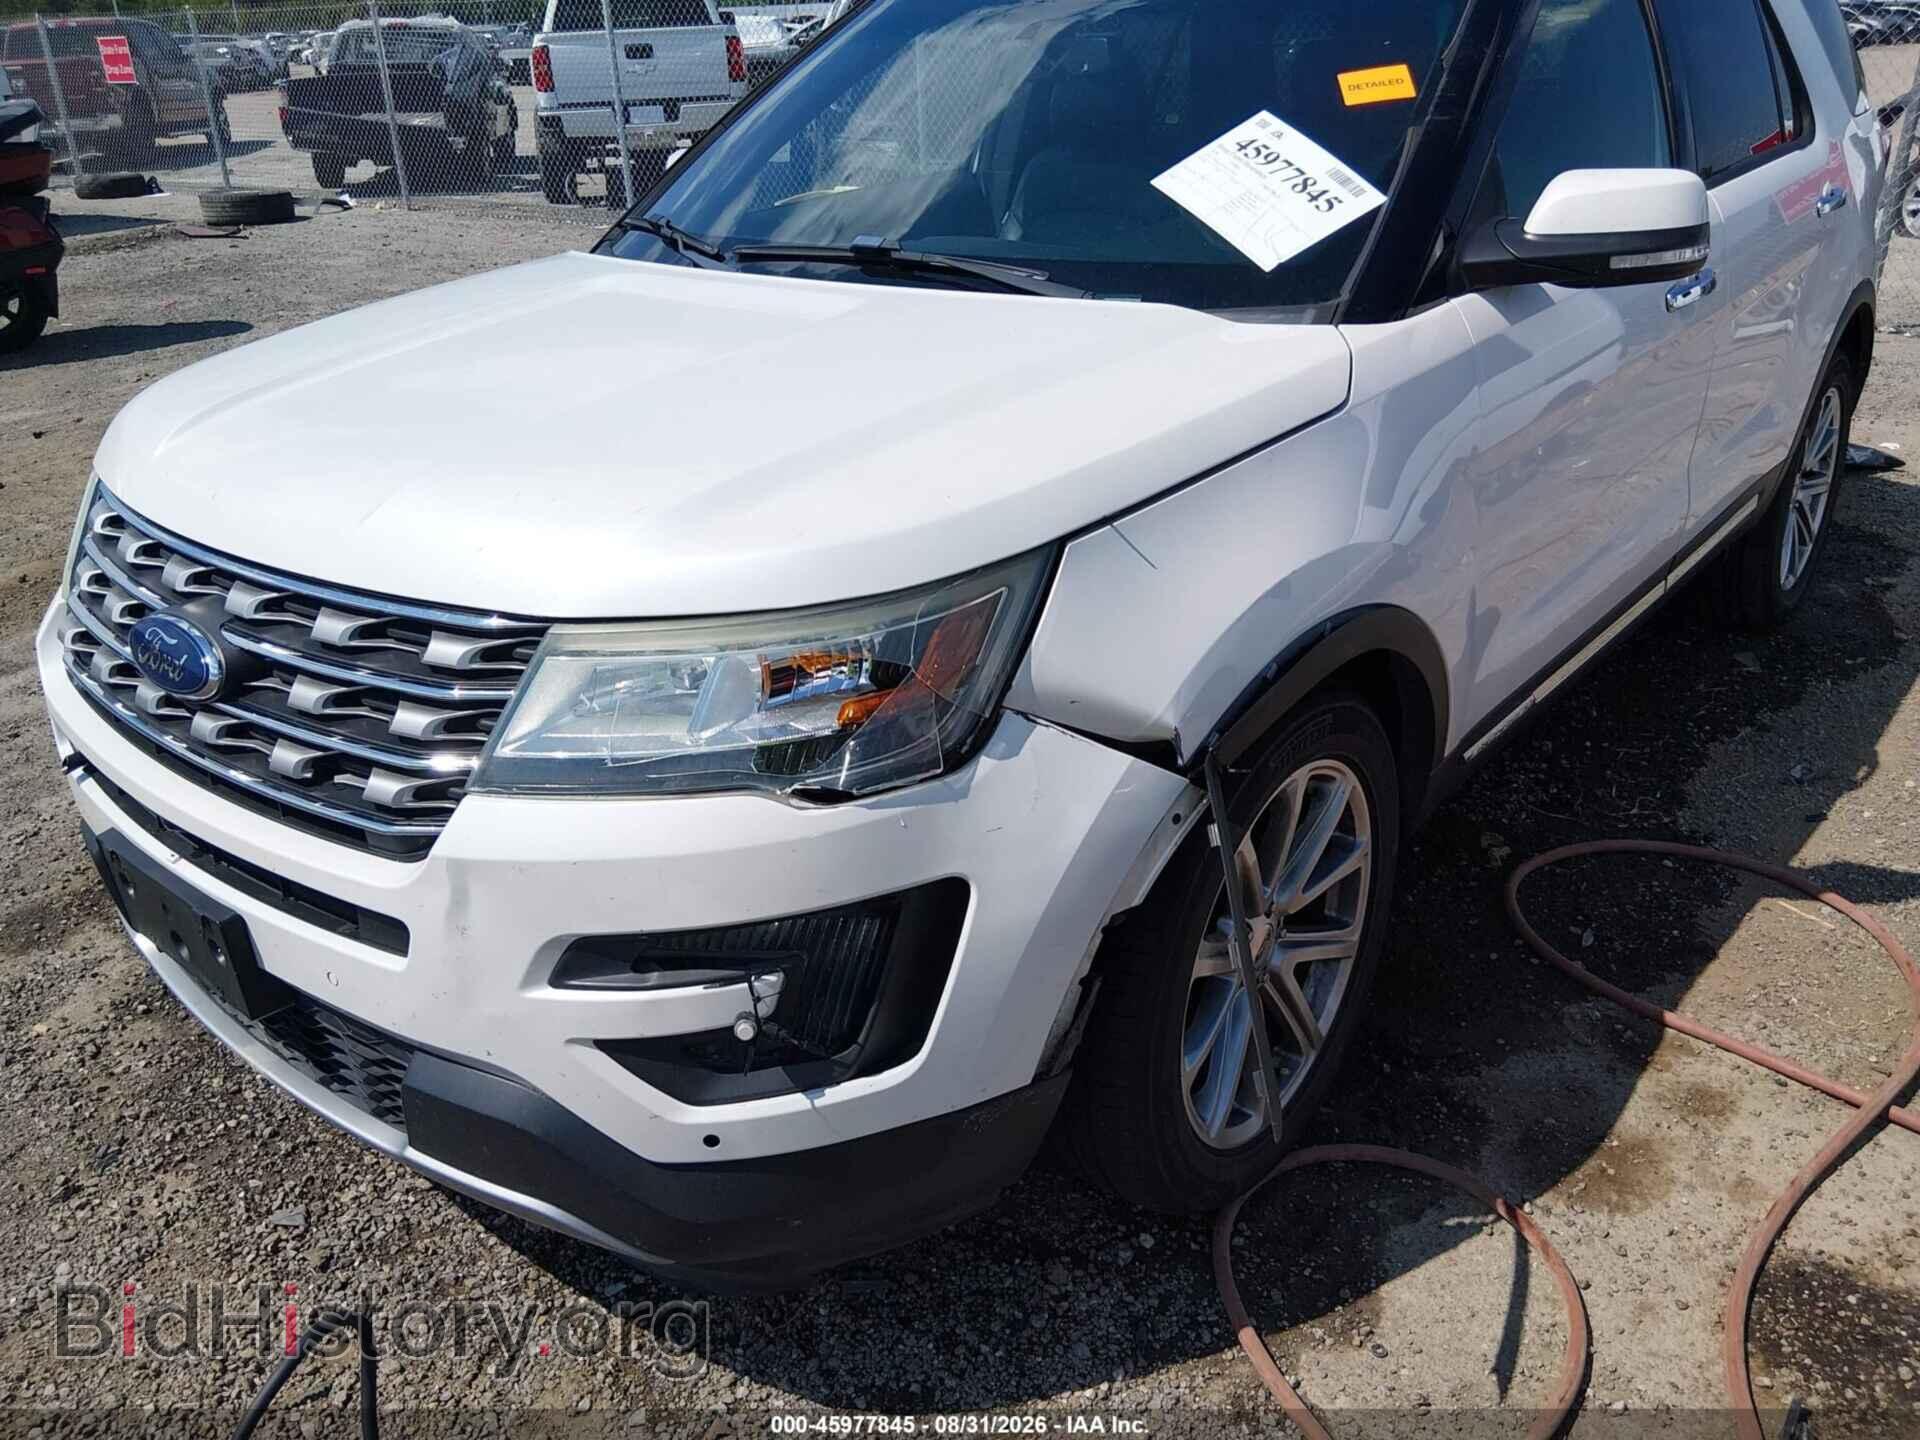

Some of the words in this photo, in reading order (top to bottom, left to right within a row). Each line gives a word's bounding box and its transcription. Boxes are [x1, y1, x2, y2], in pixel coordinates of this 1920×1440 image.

[1348, 77, 1404, 91] DETAILED
[1235, 137, 1344, 213] 45977845
[137, 626, 189, 682] Ford
